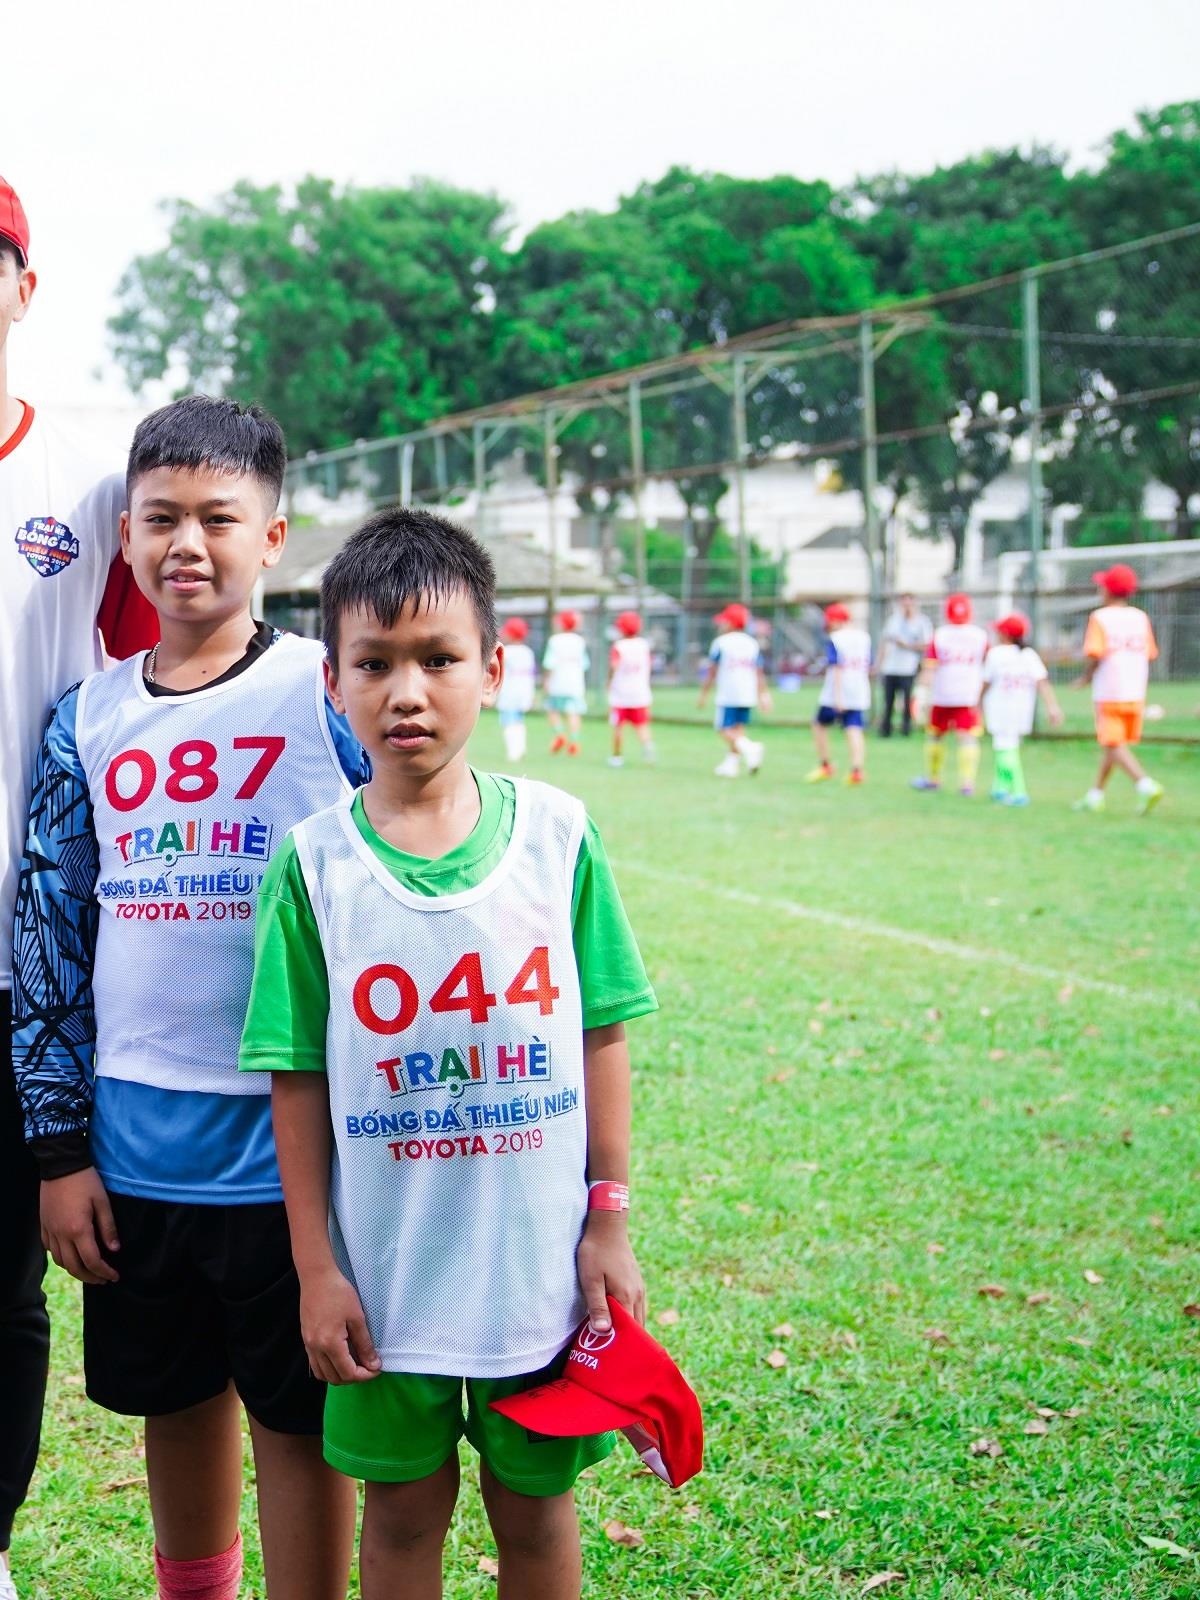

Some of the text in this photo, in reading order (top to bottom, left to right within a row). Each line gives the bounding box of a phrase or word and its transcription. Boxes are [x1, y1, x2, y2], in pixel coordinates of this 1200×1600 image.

[16, 529, 59, 548] BÓNG
[105, 736, 286, 812] 087
[115, 816, 268, 863] TRẠI HÈ
[138, 871, 169, 894] ĐÁ
[175, 868, 250, 893] THIẾU
[115, 902, 251, 920] TOYOTA 2019
[352, 946, 560, 1036] 044
[375, 1036, 548, 1093] TRẠI HÈ
[346, 1086, 578, 1136] BÓNG ĐÁ THIẾU NIÊN
[388, 1128, 543, 1161] TOYOTA 2019
[569, 1349, 599, 1370] OYOTA
